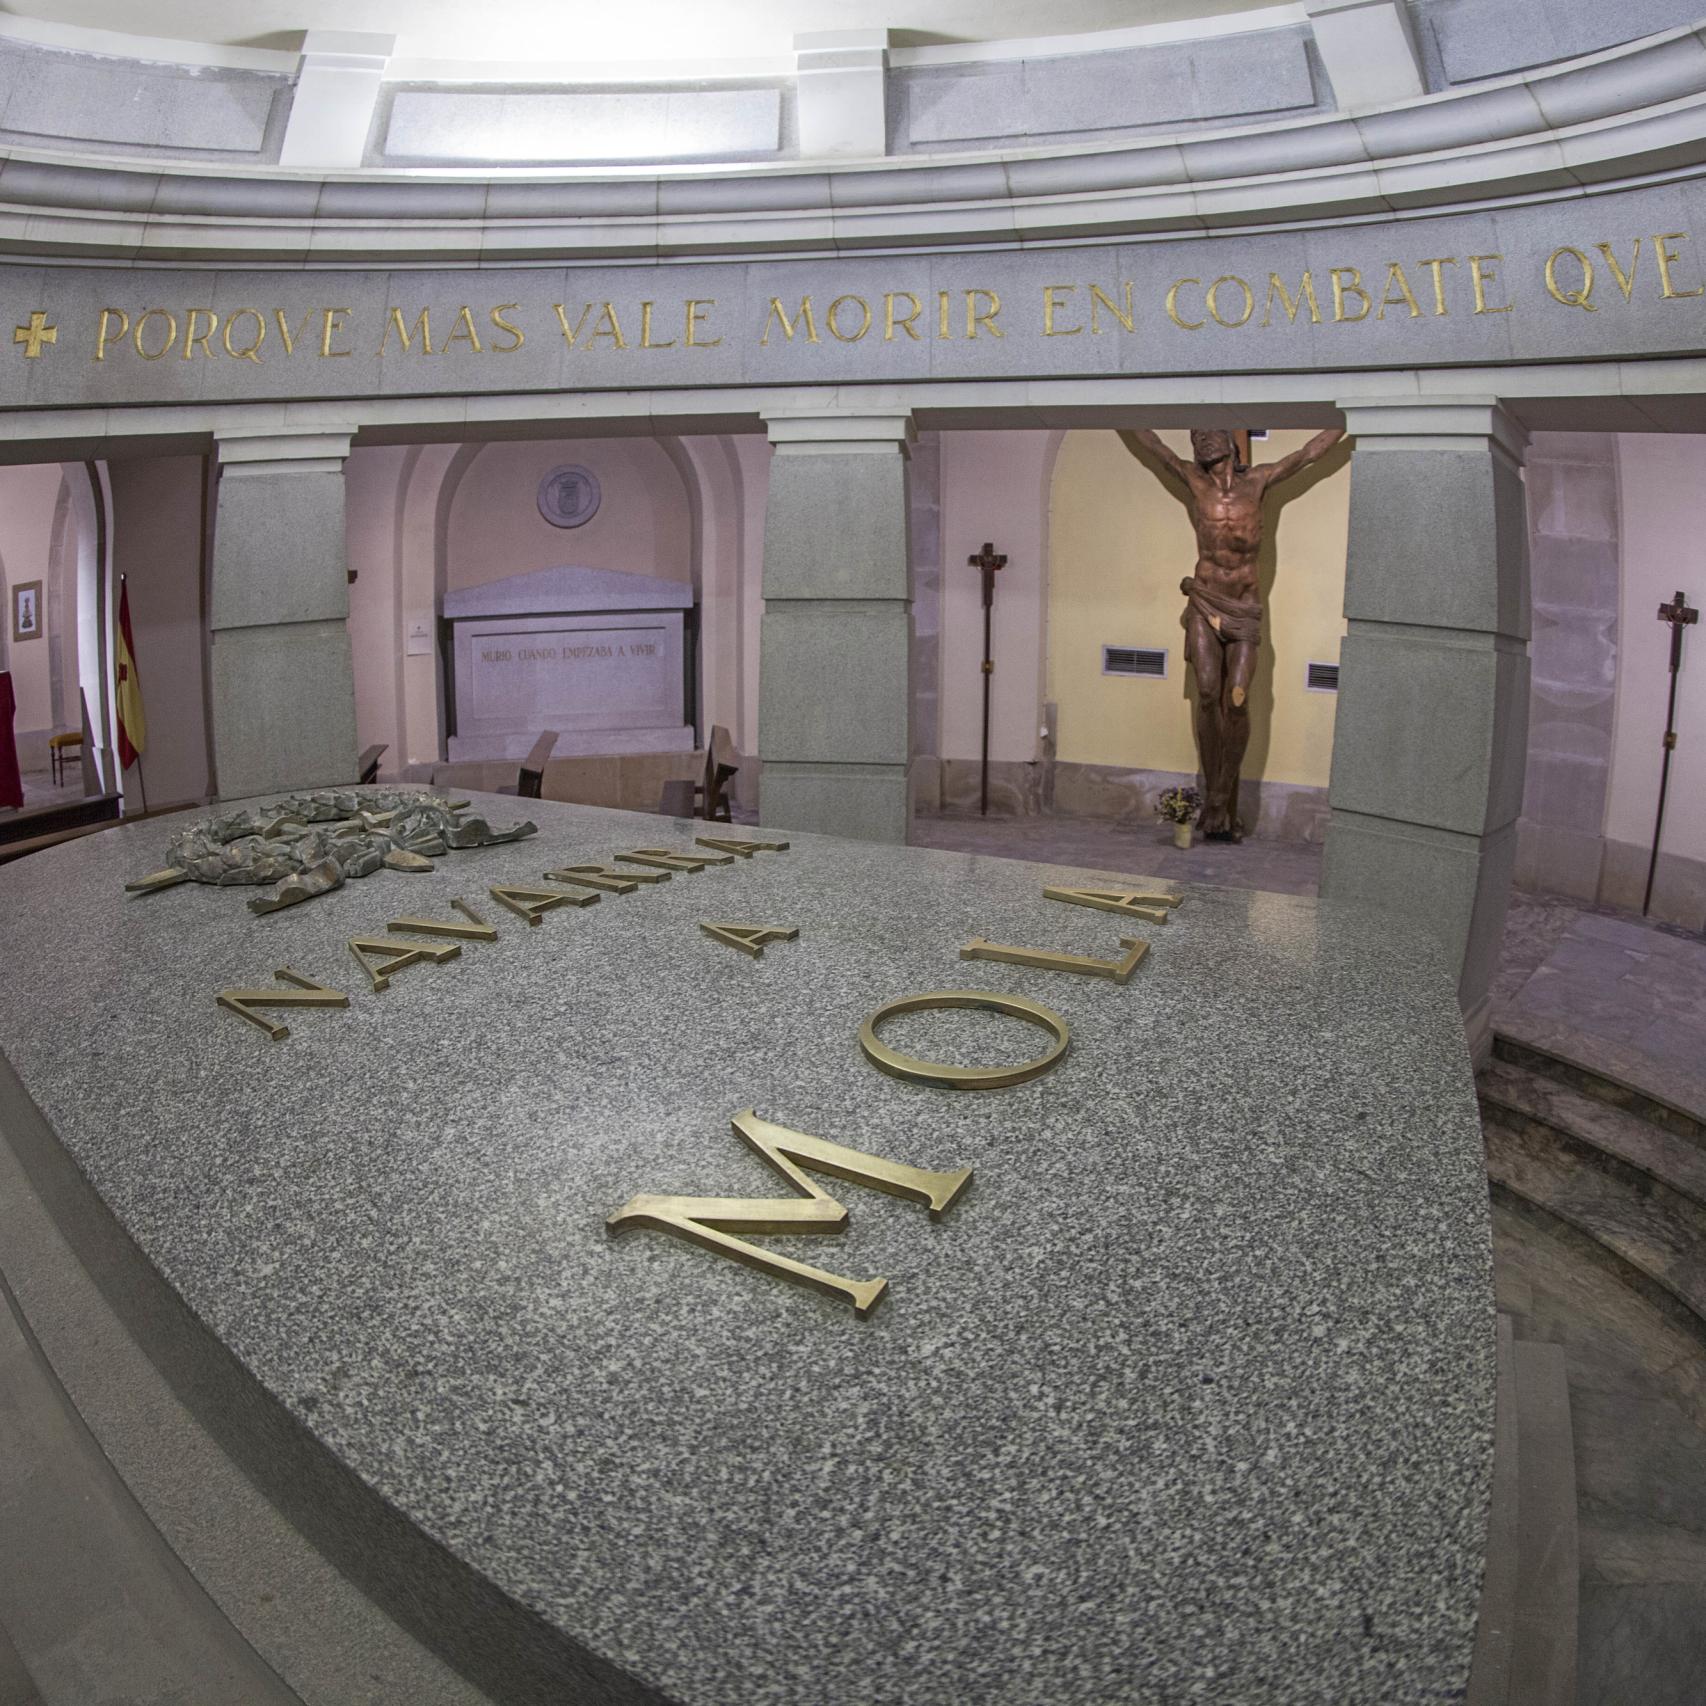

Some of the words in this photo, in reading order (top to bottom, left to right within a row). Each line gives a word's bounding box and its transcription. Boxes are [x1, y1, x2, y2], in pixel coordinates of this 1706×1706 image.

[91, 308, 352, 364] PORQVE
[376, 303, 525, 357] MAS
[552, 299, 727, 351] VALE
[760, 289, 1006, 346] MORIR
[1040, 281, 1136, 337] EN
[1165, 254, 1514, 331] COMBATE
[1544, 232, 1704, 312] QVE
[562, 645, 612, 659] EMPEZABA
[615, 645, 626, 657] A
[216, 837, 790, 1041] NAVARRA
[701, 919, 800, 960] A
[606, 886, 1185, 1322] MOLA
